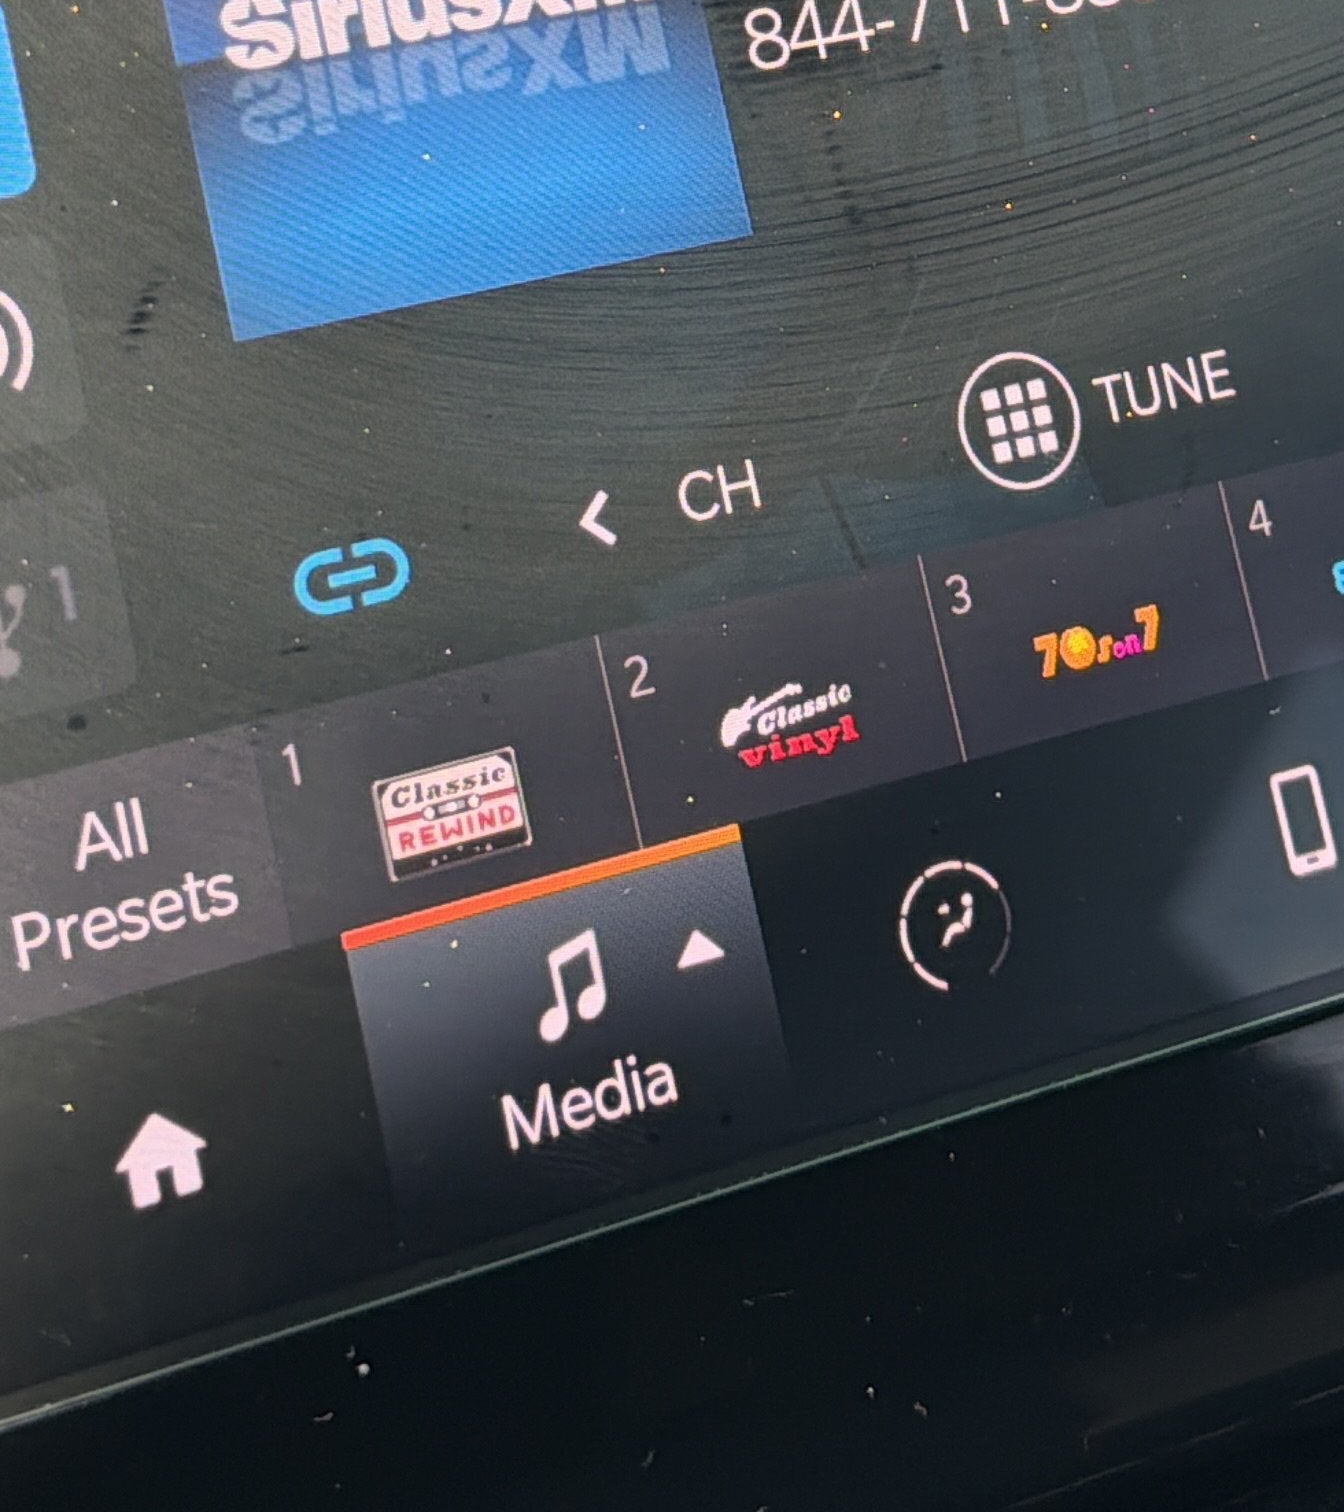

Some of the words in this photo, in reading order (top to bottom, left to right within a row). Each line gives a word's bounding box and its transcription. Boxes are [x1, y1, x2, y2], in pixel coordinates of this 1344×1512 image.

[1091, 348, 1237, 424] TUNE
[676, 458, 763, 522] CH
[1248, 499, 1273, 537] 4
[50, 564, 78, 621] 1
[945, 574, 973, 615] 3
[623, 654, 656, 698] 2
[757, 682, 853, 736] Classic
[281, 743, 303, 786] 1
[738, 714, 861, 769] vinyl
[391, 766, 507, 809] Classic
[74, 796, 150, 871] All
[398, 804, 516, 853] REWIND
[11, 871, 240, 972] Presets
[500, 1053, 679, 1152] Media
